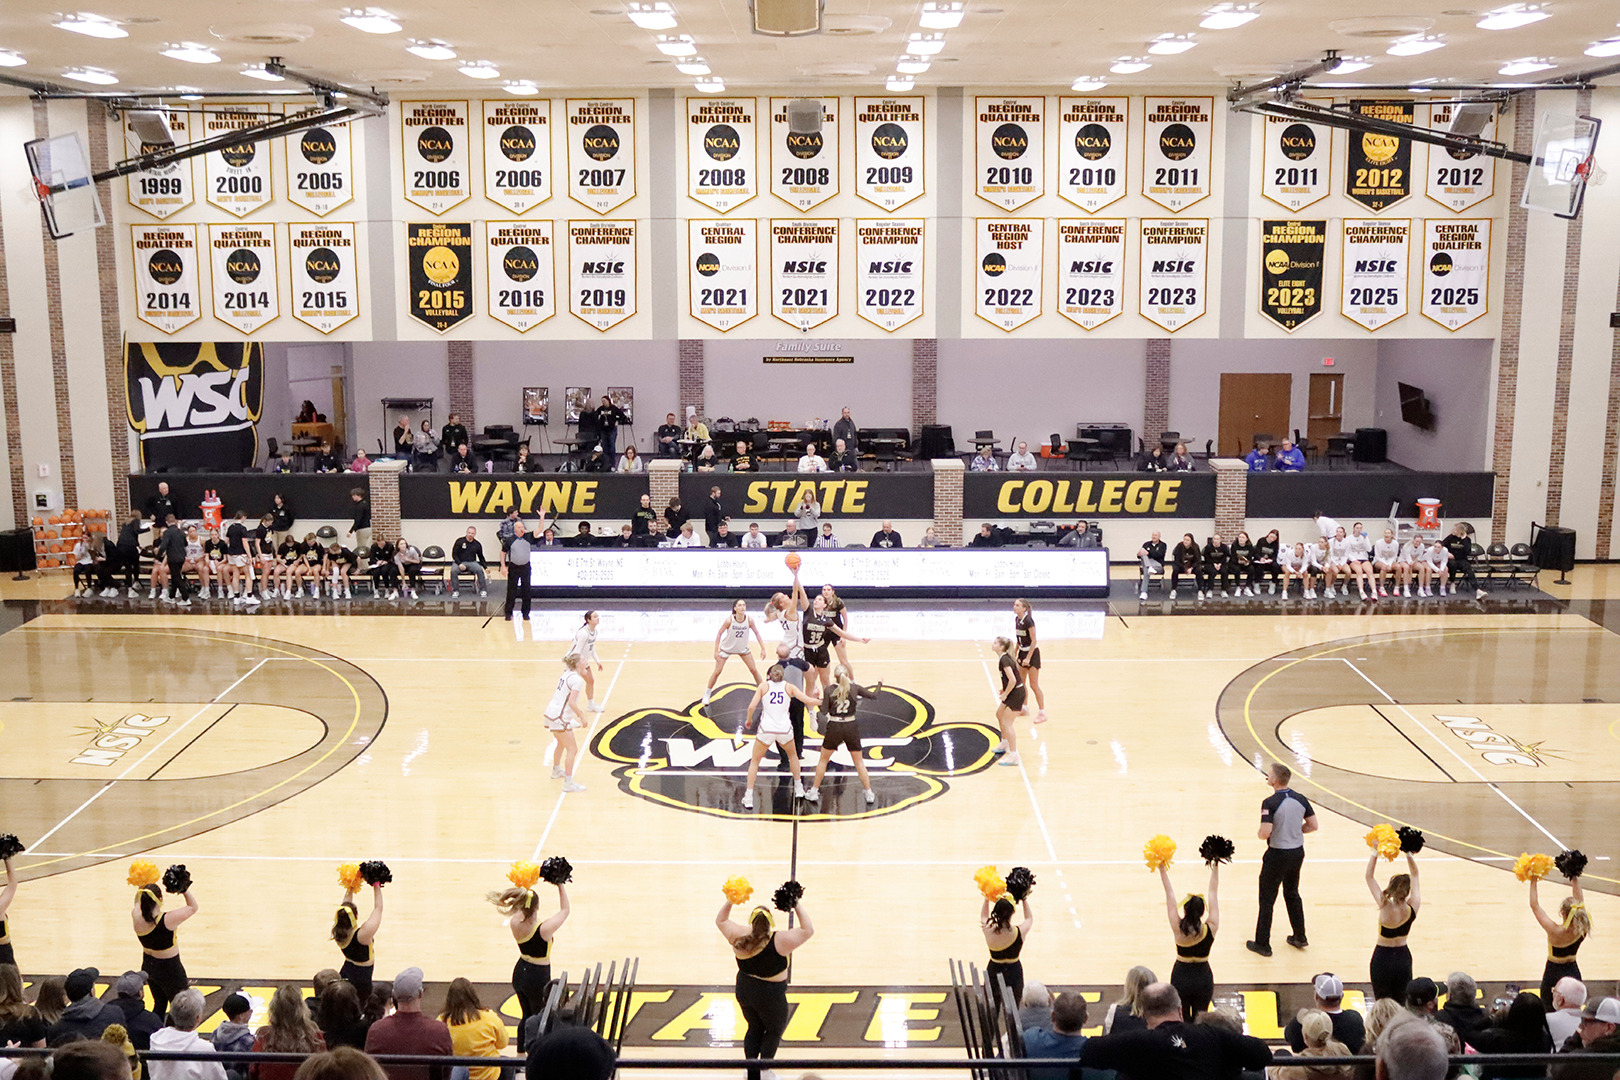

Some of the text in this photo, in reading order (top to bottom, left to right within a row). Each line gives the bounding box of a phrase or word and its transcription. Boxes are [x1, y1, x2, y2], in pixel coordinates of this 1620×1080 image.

[413, 109, 456, 117] REGION
[496, 108, 538, 116] REGION
[578, 107, 622, 115] REGION
[1361, 106, 1404, 114] REGION
[216, 113, 258, 121] REGION
[405, 117, 464, 126] QUALIFIER
[488, 116, 546, 125] QUALIFIER
[571, 115, 631, 124] QUALIFIER
[691, 115, 751, 123] QUALIFIER
[859, 114, 919, 122] QUALIFIER
[980, 114, 1040, 122] QUALIFIER
[1064, 114, 1124, 122] QUALIFIER
[1149, 114, 1208, 122] QUALIFIER
[419, 140, 451, 150] NCAA
[502, 139, 534, 149] NCAA
[584, 138, 617, 147] NCAA
[706, 138, 738, 148] NCAA
[789, 136, 821, 146] NCAA
[873, 136, 906, 146] NCAA
[994, 137, 1026, 147] NCAA
[1077, 137, 1109, 147] NCAA
[1161, 137, 1193, 147] NCAA
[1282, 137, 1313, 147] NCAA
[1366, 139, 1396, 147] NCAA
[302, 141, 334, 152] NCAA
[414, 171, 459, 188] 2006
[496, 170, 541, 187] 2006
[579, 169, 626, 186] 2007
[699, 169, 745, 186] 2008
[782, 168, 829, 185] 2008
[867, 167, 912, 184] 2009
[987, 168, 1032, 184] 2010
[1070, 168, 1116, 185] 2010
[1156, 168, 1198, 185] 2011
[1276, 168, 1318, 185] 2011
[1356, 169, 1403, 187] 2012
[1437, 168, 1483, 185] 2012
[217, 176, 261, 193] 2000
[297, 173, 342, 189] 2005
[140, 179, 181, 194] 1999
[418, 229, 461, 237] REGION
[571, 228, 633, 236] CONFERENCE
[701, 228, 745, 236] CENTRAL
[773, 227, 837, 235] CONFERENCE
[859, 228, 922, 236] CONFERENCE
[988, 224, 1032, 232] CENTRAL
[1061, 226, 1124, 234] CONFERENCE
[1272, 226, 1315, 235] REGION
[1346, 227, 1408, 235] CONFERENCE
[1435, 225, 1478, 233] CENTRAL
[144, 232, 184, 240] REGION
[491, 237, 549, 245] QUALIFIER
[576, 237, 630, 245] CHAMPION
[705, 236, 742, 244] REGION
[863, 236, 918, 244] CHAMPION
[992, 233, 1028, 241] REGION
[1065, 235, 1119, 243] CHAMPION
[1147, 236, 1201, 244] CHAMPION
[1263, 235, 1324, 243] CHAMPION
[137, 240, 193, 249] QUALIFIER
[214, 239, 271, 248] QUALIFIER
[293, 239, 351, 247] QUALIFIER
[409, 237, 470, 246] CHAMPION
[997, 241, 1023, 249] HOST
[1432, 242, 1481, 250] QUALIFIER
[150, 263, 181, 272] NCAA
[228, 262, 259, 271] NCAA
[307, 261, 338, 271] NCAA
[425, 261, 456, 270] NCAA
[505, 259, 537, 269] NCAA
[582, 262, 624, 273] NSIC
[784, 262, 827, 272] NSIC
[869, 262, 913, 272] NSIC
[1070, 261, 1113, 272] NSIC
[1152, 261, 1195, 272] NSIC
[1291, 261, 1314, 269] Division
[1355, 260, 1397, 272] NSIC
[147, 293, 190, 308] 2014
[225, 292, 269, 308] 2014
[302, 292, 346, 308] 2015
[419, 291, 464, 308] 2015
[499, 290, 544, 307] 2016
[581, 290, 625, 306] 2019
[701, 289, 746, 305] 2021
[782, 289, 827, 305] 2021
[866, 289, 914, 305] 2022
[985, 289, 1033, 305] 2022
[1066, 289, 1114, 306] 2023
[1148, 288, 1196, 305] 2023
[1268, 289, 1315, 307] 2023
[1350, 289, 1398, 305] 2025
[1431, 289, 1478, 305] 2025
[776, 343, 841, 352] Family Suite
[448, 480, 1182, 513] WAYNE STATE COLLEGE
[204, 510, 212, 518] G
[1425, 508, 1434, 516] G
[810, 632, 822, 643] 35
[769, 691, 784, 705] 25
[836, 700, 850, 713] 22
[69, 713, 170, 767] NSIC
[1432, 714, 1540, 767] NSIC
